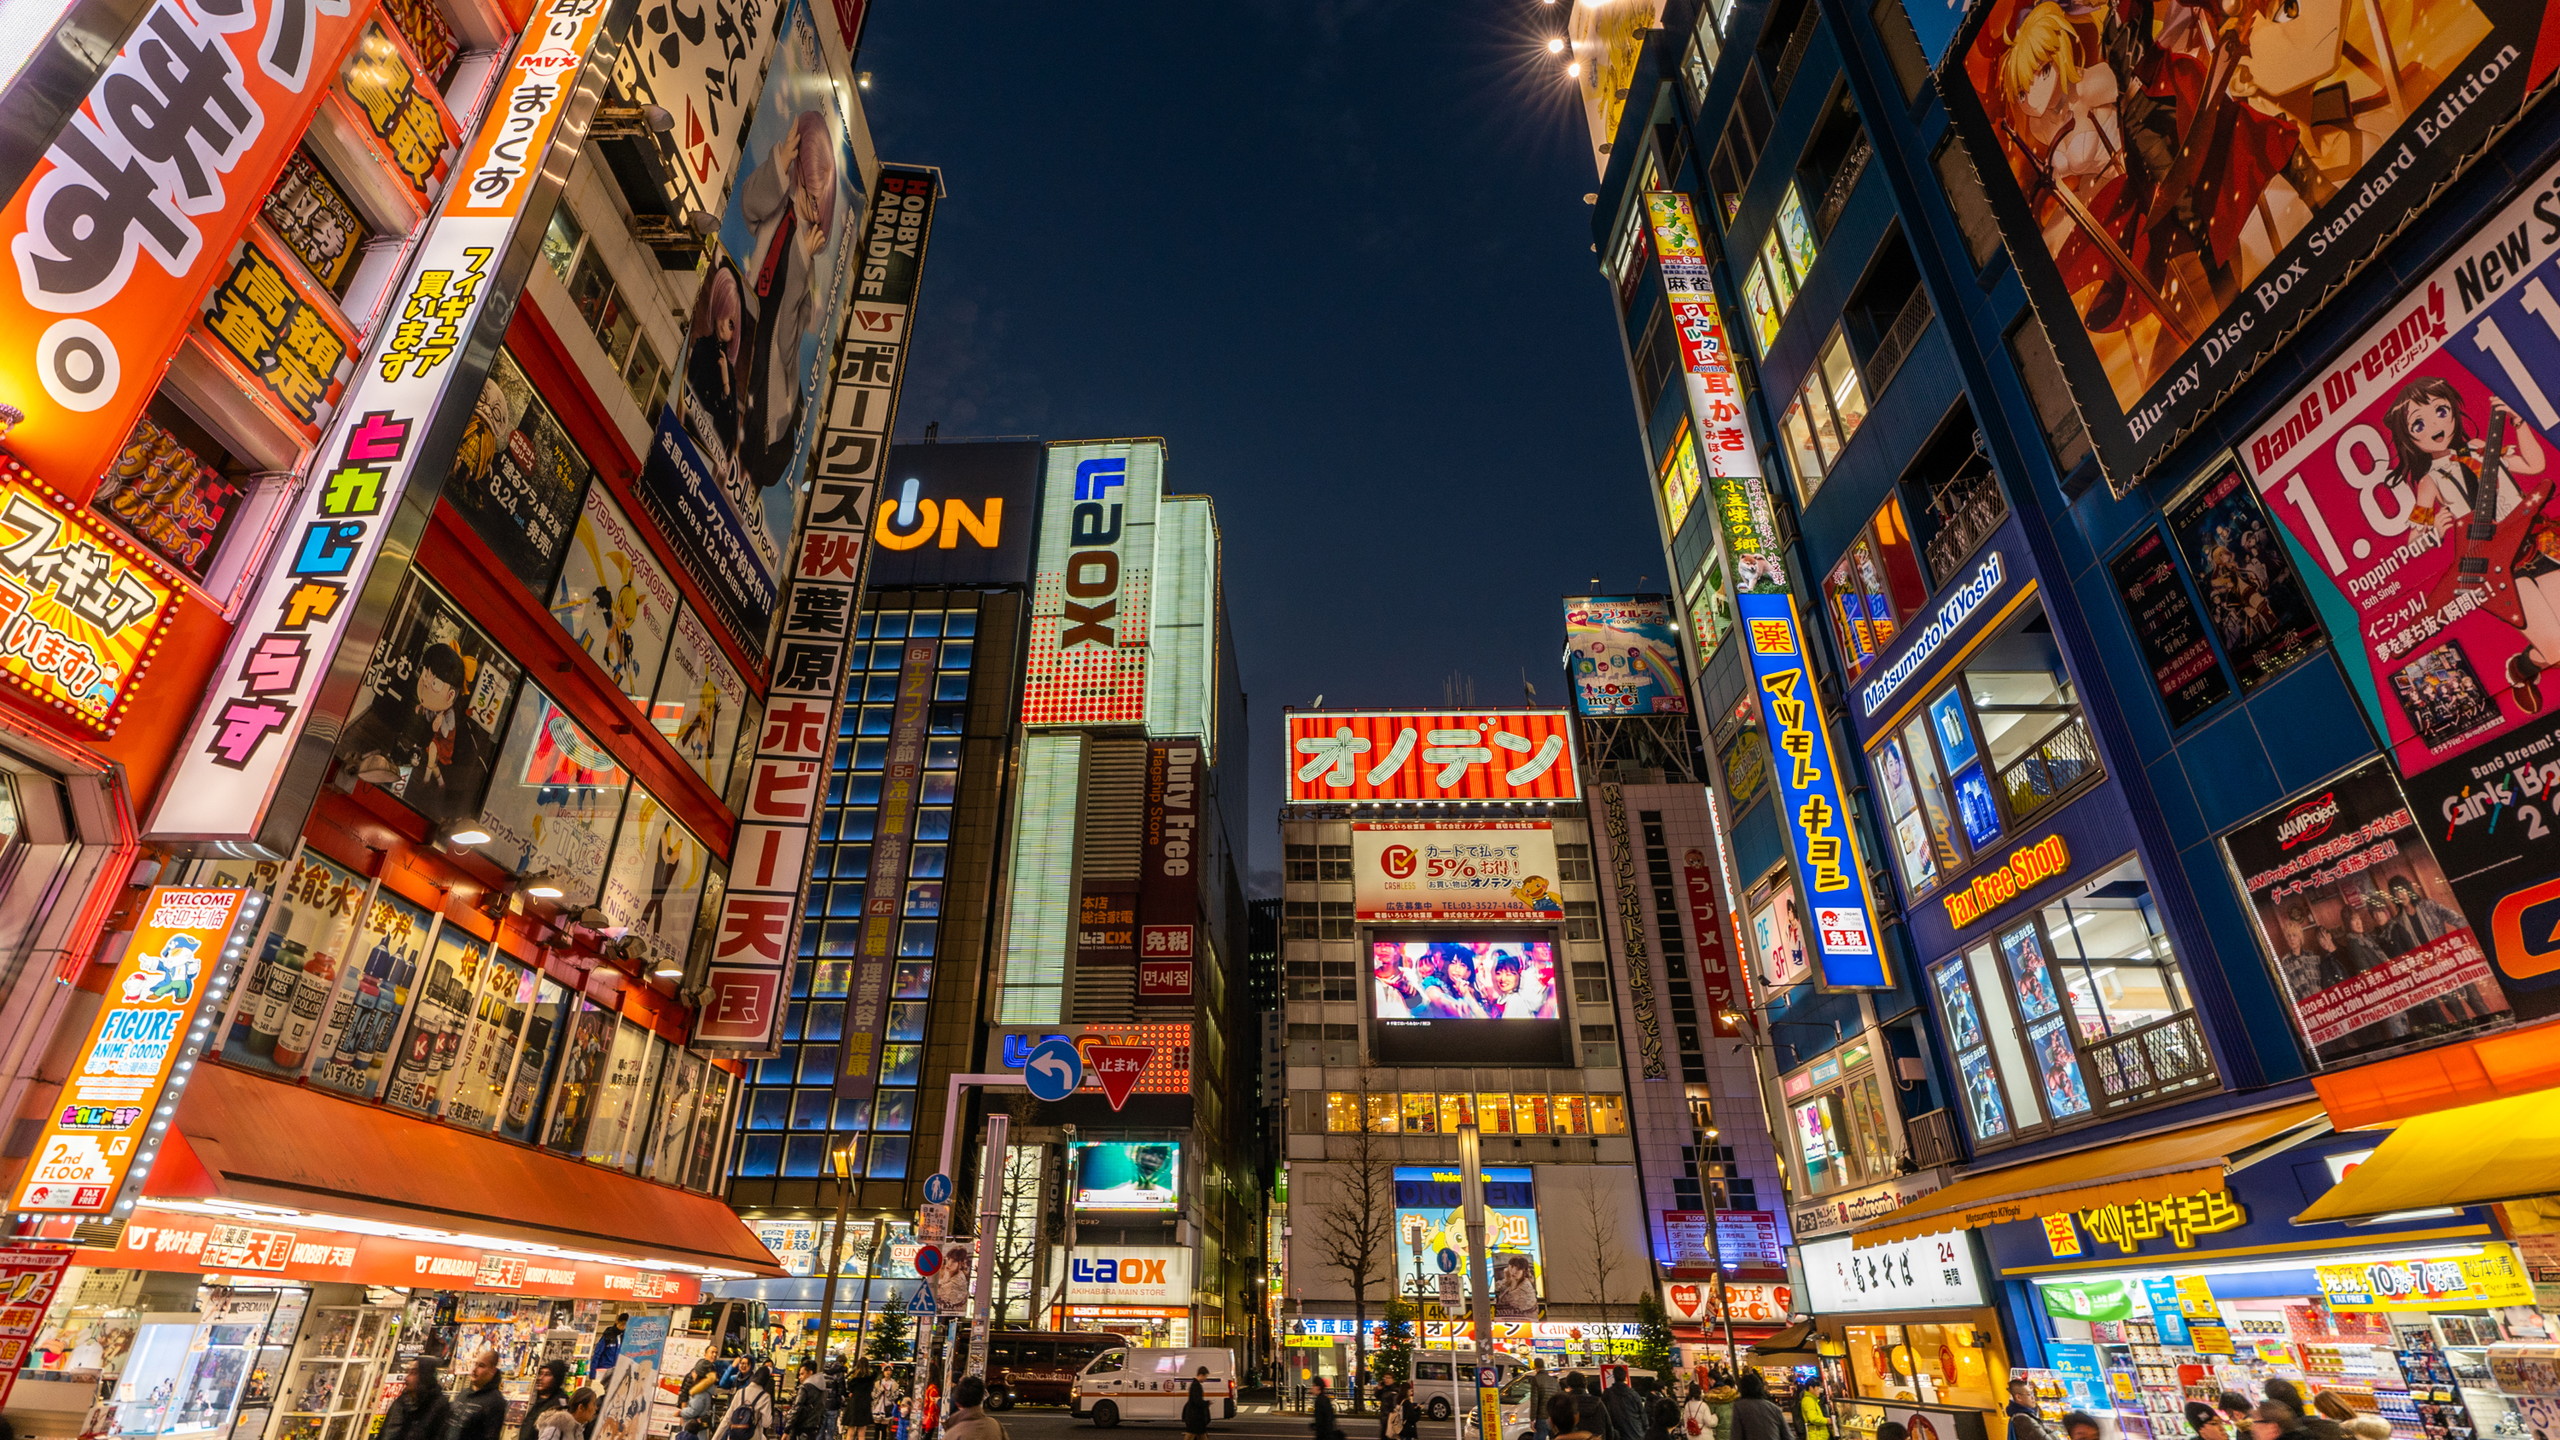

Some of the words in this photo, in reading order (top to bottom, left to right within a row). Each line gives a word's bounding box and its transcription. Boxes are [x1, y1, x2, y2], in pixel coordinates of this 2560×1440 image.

[475, 84, 556, 199] まっくす
[895, 179, 928, 258] HOBBY
[859, 177, 904, 297] PARADISE
[2126, 364, 2201, 443] Blu-ray
[2200, 311, 2256, 368] Disc
[2253, 266, 2310, 314] Box
[2308, 142, 2417, 257] Standard
[2414, 44, 2521, 148] Edition
[2453, 221, 2534, 315] New
[1668, 277, 1712, 293] 麻雀
[380, 271, 453, 383] 買います
[412, 247, 493, 378] フィギュア
[1694, 365, 1727, 373] AKIBA
[2389, 339, 2431, 379] バンドリ
[1701, 372, 1745, 452] 耳かき
[1702, 418, 1726, 477] もみほぐし
[490, 475, 518, 515] 8.24
[2285, 435, 2416, 577] 1.8
[0, 495, 156, 637] フィギュア
[2348, 528, 2442, 597] Poppin'Party
[207, 410, 408, 770] とれじゃらす
[2361, 594, 2380, 610] 15th
[2377, 580, 2402, 602] Single
[1591, 608, 1663, 619] ラブメルシー
[2375, 580, 2496, 663] 夢を撃ち抜く瞬間に!
[1753, 622, 1791, 653] 薬
[909, 648, 931, 661] 6F
[1864, 625, 1942, 717] Matsumoto
[700, 345, 896, 1040] ボークス秋葉原ホビー天国
[1598, 684, 1638, 695] LOVE
[1296, 717, 1564, 789] オノデン
[2471, 756, 2505, 779] BanG
[2505, 734, 2554, 765] Dream!
[889, 764, 916, 779] 5F
[1149, 747, 1166, 802] Flagship
[1163, 747, 1197, 809] Duty
[1762, 668, 1849, 892] マツモトキヨシ
[2442, 781, 2514, 826] Girls
[1149, 806, 1162, 846] Store
[1163, 814, 1197, 878] Free
[1425, 844, 1519, 858] カードで払って
[2247, 875, 2266, 892] JAM
[2266, 862, 2298, 885] Project
[2297, 808, 2413, 869] 20周年記念コラボ企画
[1384, 882, 1416, 890] CASHLESS
[1944, 878, 1977, 931] Tax
[1972, 863, 2015, 917] Free
[2009, 835, 2067, 890] Shop
[2271, 840, 2399, 904] ゲーマーズにて実施決定!!
[162, 893, 236, 906] WELCOME
[868, 900, 896, 915] 4F
[1081, 896, 1109, 910] 本店
[1386, 901, 1433, 910] 広告募集中
[151, 908, 227, 929] 欢迎光临
[1146, 930, 1188, 952] 免税
[1758, 918, 1769, 950] 2F
[1828, 931, 1862, 945] 免税
[271, 968, 297, 985] PANZER
[1772, 947, 1787, 979] 3F
[269, 983, 289, 995] ACES
[1143, 970, 1189, 988] 면세점
[2317, 1008, 2346, 1027] Project
[2346, 1000, 2363, 1015] 20th
[2363, 975, 2414, 1008] Anniversary
[2413, 959, 2457, 983] Complete
[294, 998, 321, 1014] COLOR
[300, 987, 326, 1003] MODEL
[2349, 1016, 2361, 1029] JAM
[2361, 1006, 2390, 1024] Project
[2409, 978, 2457, 1006] Anniversary
[2457, 966, 2490, 987] Album
[101, 1010, 183, 1042] FIGURE
[93, 1044, 127, 1059] ANIME
[129, 1044, 168, 1059] GOODS
[1099, 1058, 1140, 1073] 止まれ
[322, 1062, 367, 1091] いずれも
[60, 1107, 142, 1124] とれじゃらす
[49, 1143, 83, 1164] 2nd
[41, 1167, 94, 1180] FLOOR
[78, 1196, 98, 1205] FREE
[1966, 1208, 1998, 1223] Matsumoto
[291, 1243, 329, 1266] HOBBY
[329, 1247, 356, 1267] 天国
[1938, 1242, 1954, 1262] 24
[429, 1258, 477, 1278] AKIHABARA
[524, 1266, 548, 1283] HOBBY
[547, 1269, 576, 1286] PARADISE
[1943, 1268, 1961, 1286] 時間
[2463, 1255, 2515, 1279] 松本清
[1071, 1288, 1116, 1296] AKIHABARA
[2332, 1295, 2347, 1303] TAX
[2347, 1294, 2366, 1303] FREE
